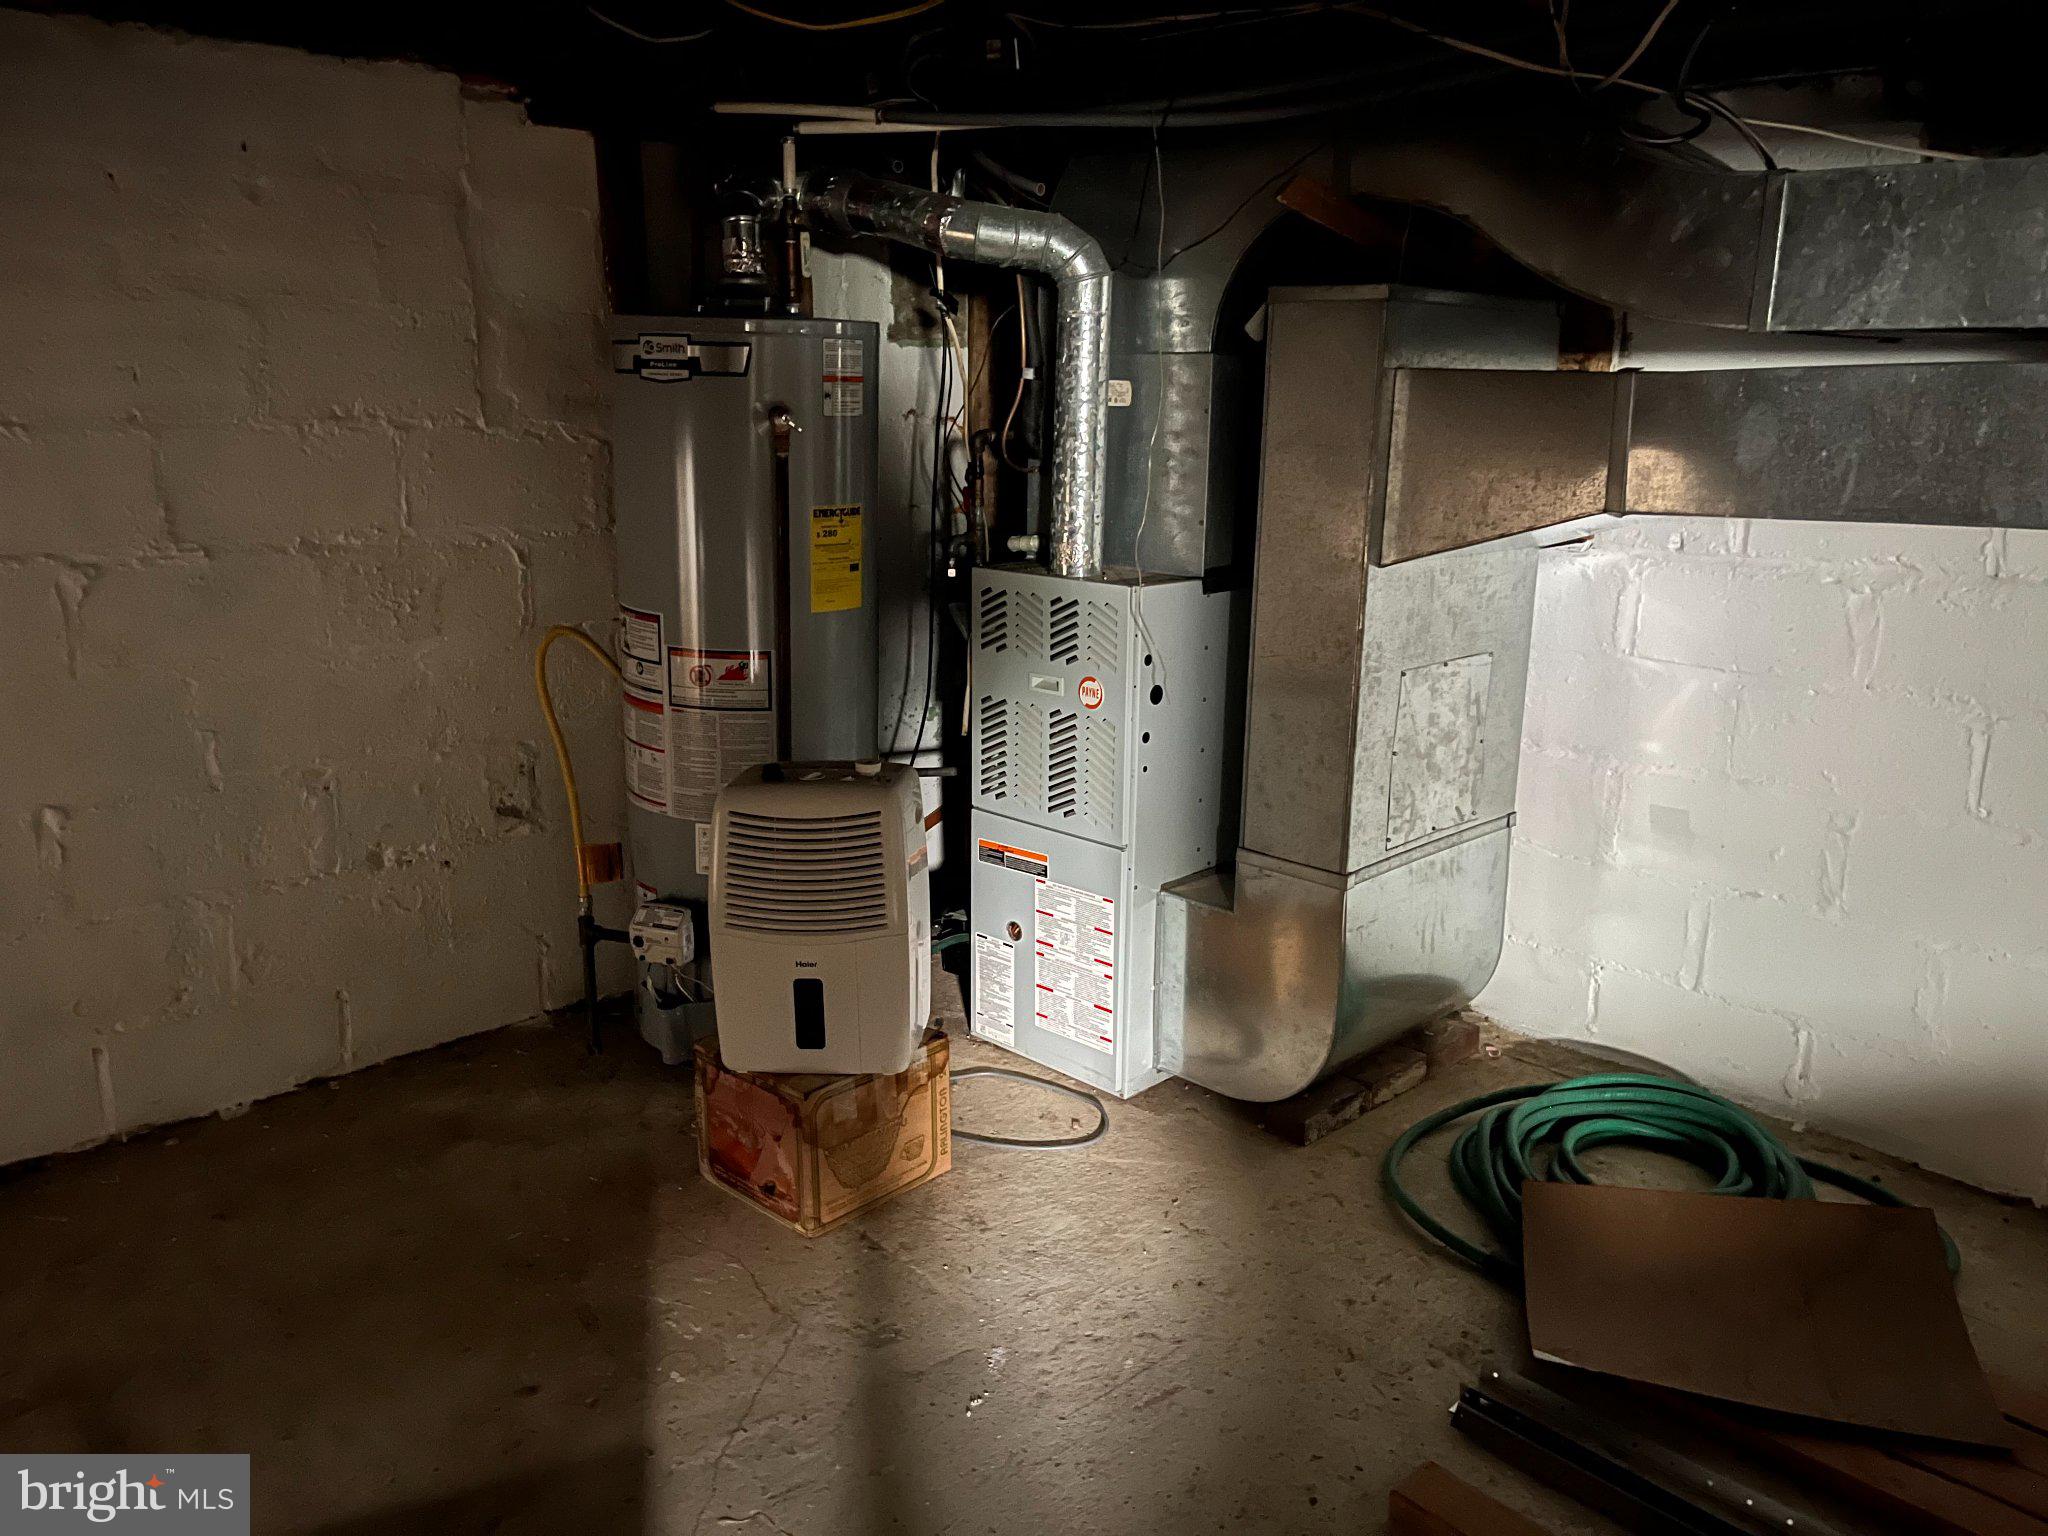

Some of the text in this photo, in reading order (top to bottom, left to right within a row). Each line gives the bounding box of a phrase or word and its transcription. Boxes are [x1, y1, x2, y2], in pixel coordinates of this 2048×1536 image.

[656, 341, 685, 353] Smith
[822, 529, 838, 537] 280
[1081, 686, 1100, 699] PAYNE
[795, 960, 818, 968] Haier
